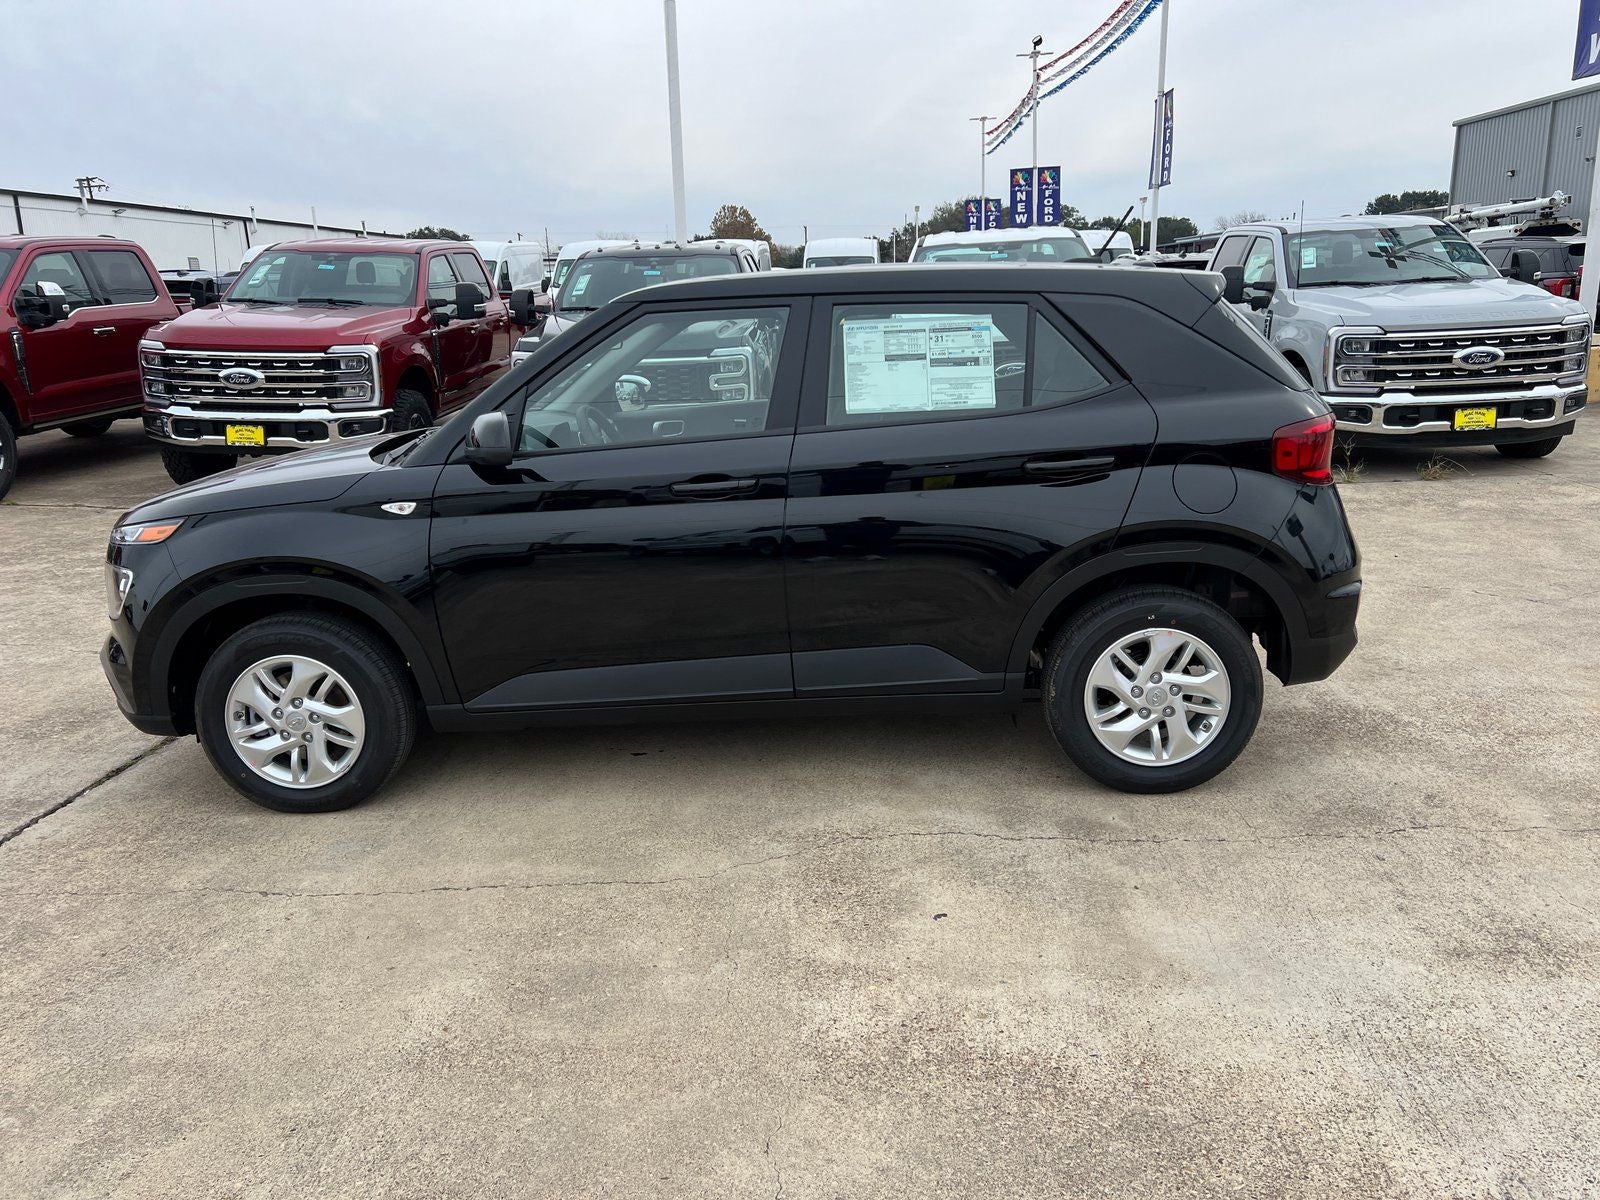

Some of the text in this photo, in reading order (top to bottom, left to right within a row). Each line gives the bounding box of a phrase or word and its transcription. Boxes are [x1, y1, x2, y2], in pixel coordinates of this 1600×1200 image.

[1163, 129, 1171, 182] FORD
[1015, 191, 1027, 224] NEW
[1044, 190, 1054, 223] FORD
[969, 216, 977, 231] NE
[934, 335, 944, 343] 31
[1468, 352, 1493, 364] Ford
[229, 373, 251, 384] Ford
